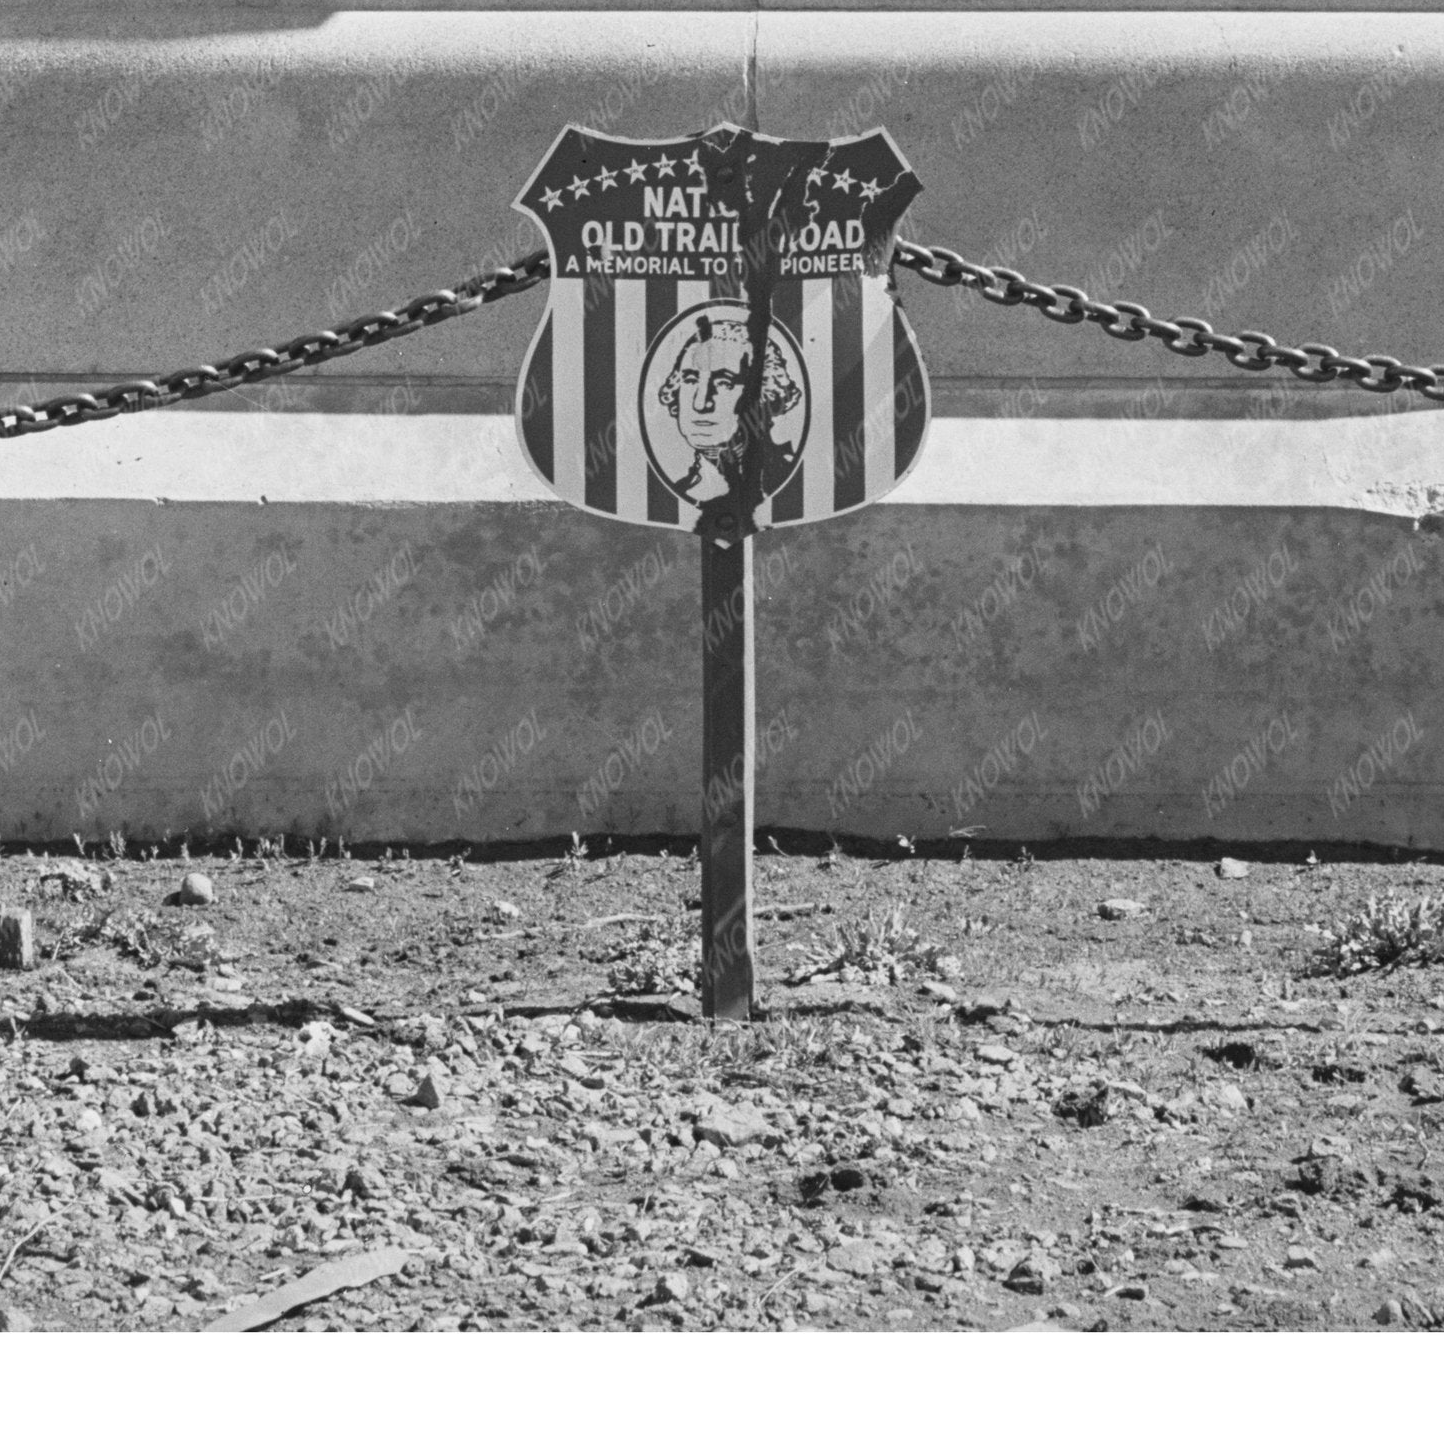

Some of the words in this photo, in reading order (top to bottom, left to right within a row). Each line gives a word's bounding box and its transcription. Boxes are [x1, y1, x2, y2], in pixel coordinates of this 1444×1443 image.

[581, 220, 645, 252] OLD
[565, 255, 580, 272] A
[586, 256, 695, 275] MEMORIAL
[700, 257, 728, 275] TO
